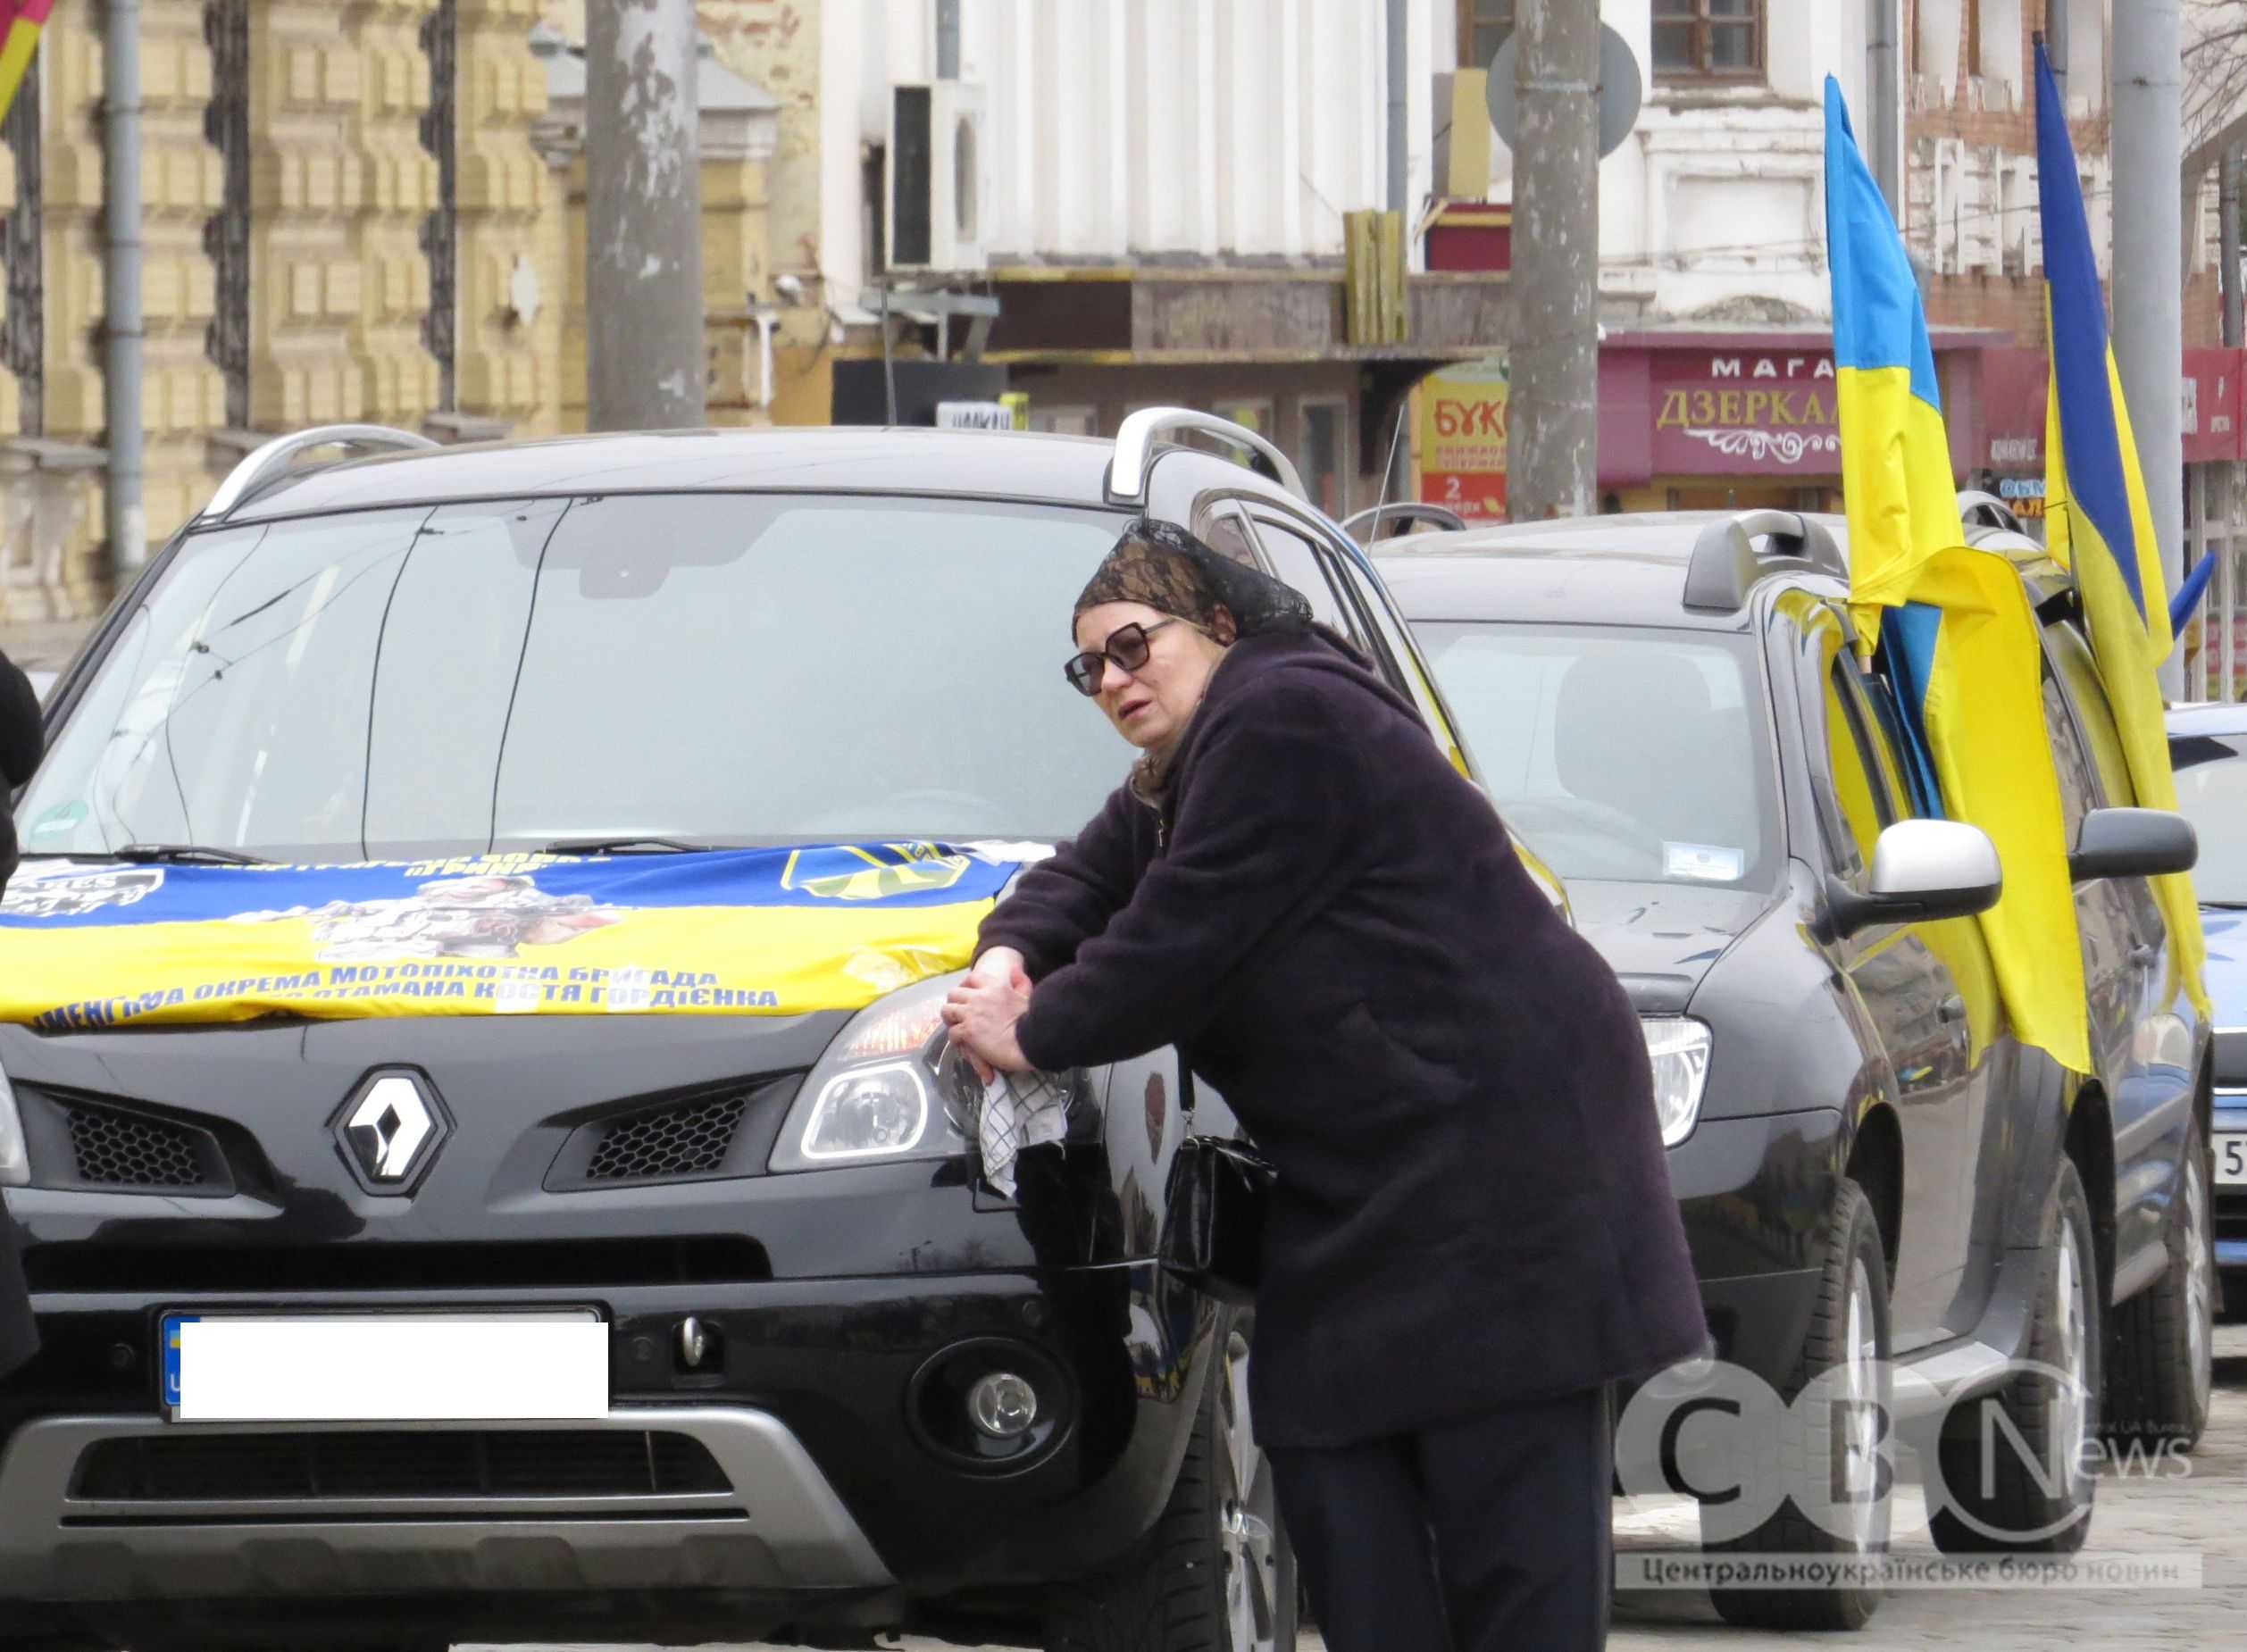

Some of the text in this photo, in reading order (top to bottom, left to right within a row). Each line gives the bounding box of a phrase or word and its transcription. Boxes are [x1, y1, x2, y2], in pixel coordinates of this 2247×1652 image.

[1434, 398, 1509, 438] БУК
[193, 971, 320, 1000] ОКРЕМА
[568, 966, 718, 989] БРИГАДА
